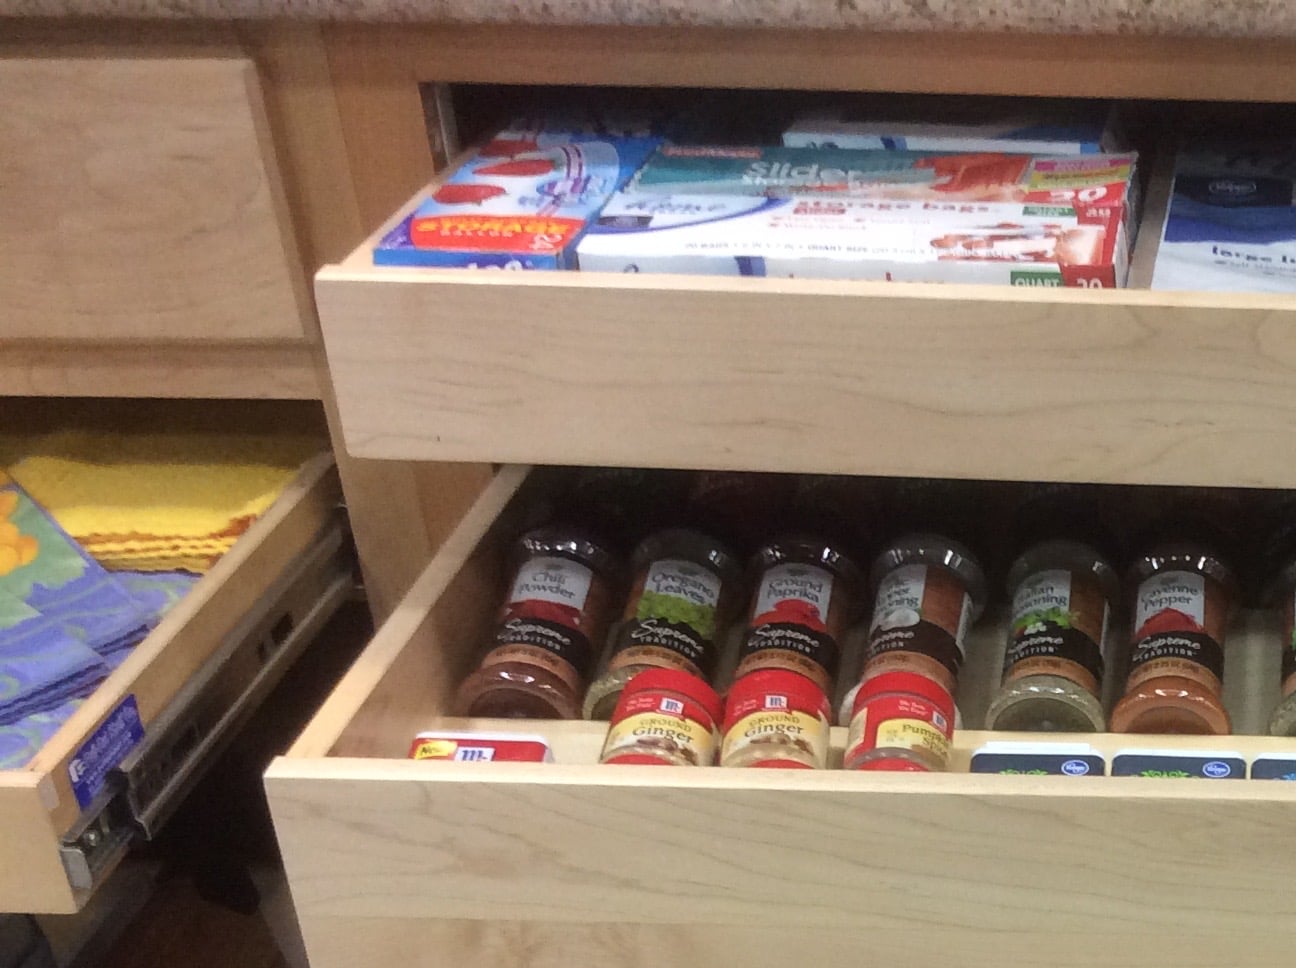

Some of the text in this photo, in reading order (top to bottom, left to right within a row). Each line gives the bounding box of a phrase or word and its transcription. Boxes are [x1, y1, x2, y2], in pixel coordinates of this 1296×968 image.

[531, 571, 567, 585] Chili
[518, 581, 576, 600] Powder
[767, 588, 819, 604] Paprika
[497, 618, 571, 646] Supreme
[631, 619, 704, 653] Supreme
[748, 623, 820, 649] Supreme
[503, 632, 561, 651] TRADITION
[640, 634, 697, 658] TRADITION
[755, 638, 811, 654] TRADITION
[1132, 636, 1201, 661] Supreme
[640, 718, 692, 732] GROUND
[749, 715, 801, 727] GROUND
[632, 726, 695, 743] Ginger
[744, 723, 804, 738] Ginger
